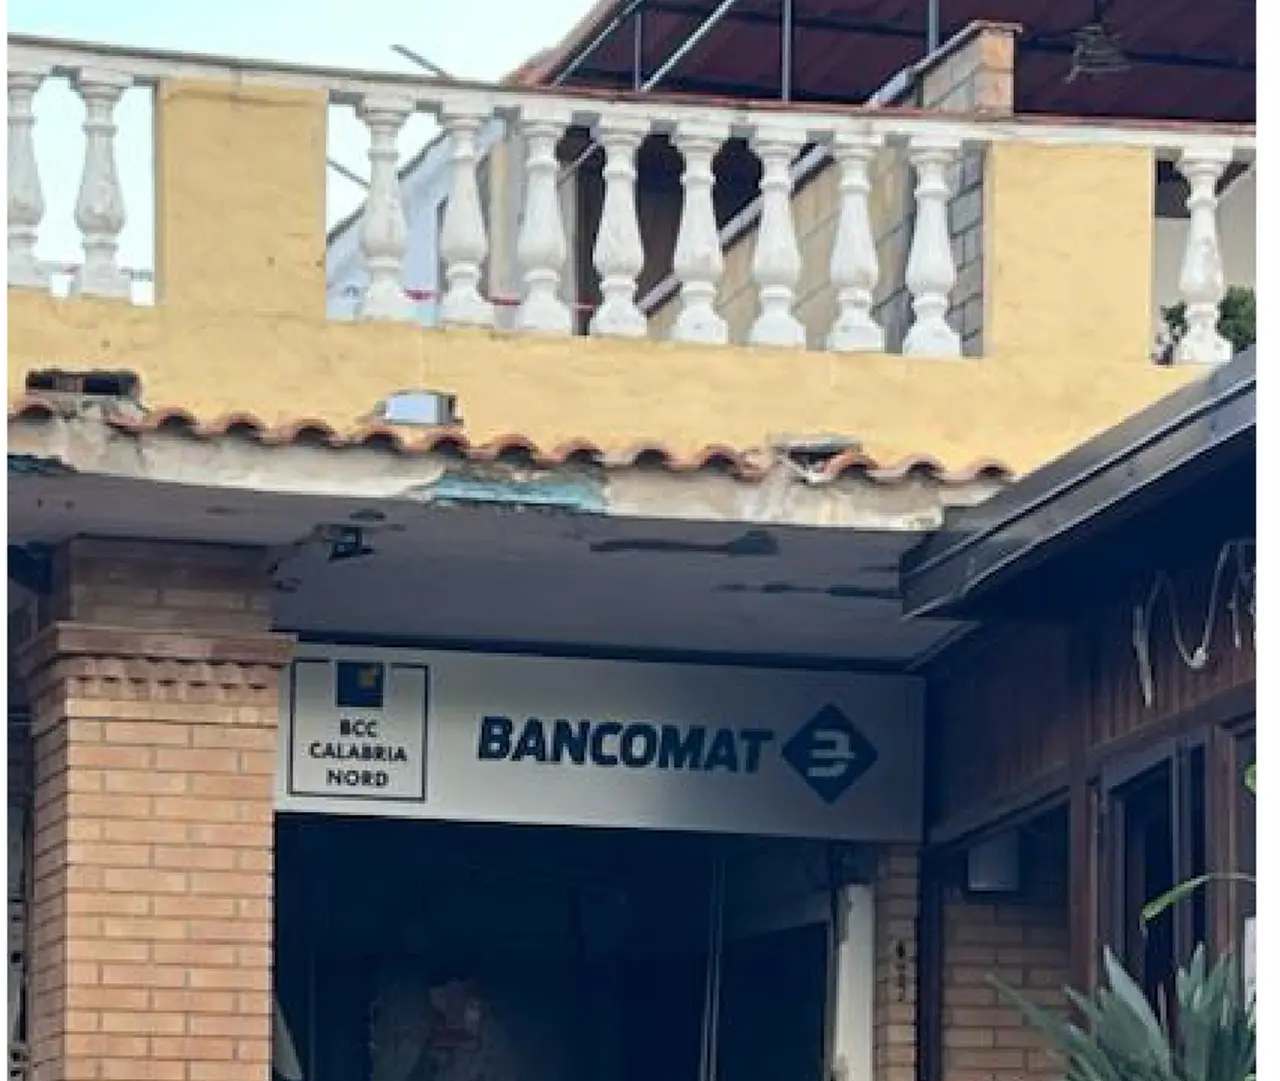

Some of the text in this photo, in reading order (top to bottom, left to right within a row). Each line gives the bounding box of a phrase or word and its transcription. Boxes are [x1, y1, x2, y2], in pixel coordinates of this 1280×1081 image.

[339, 719, 378, 737] BCC
[308, 741, 407, 761] CALABRIA
[477, 717, 774, 773] BANCOMAT
[326, 769, 389, 786] NORD
